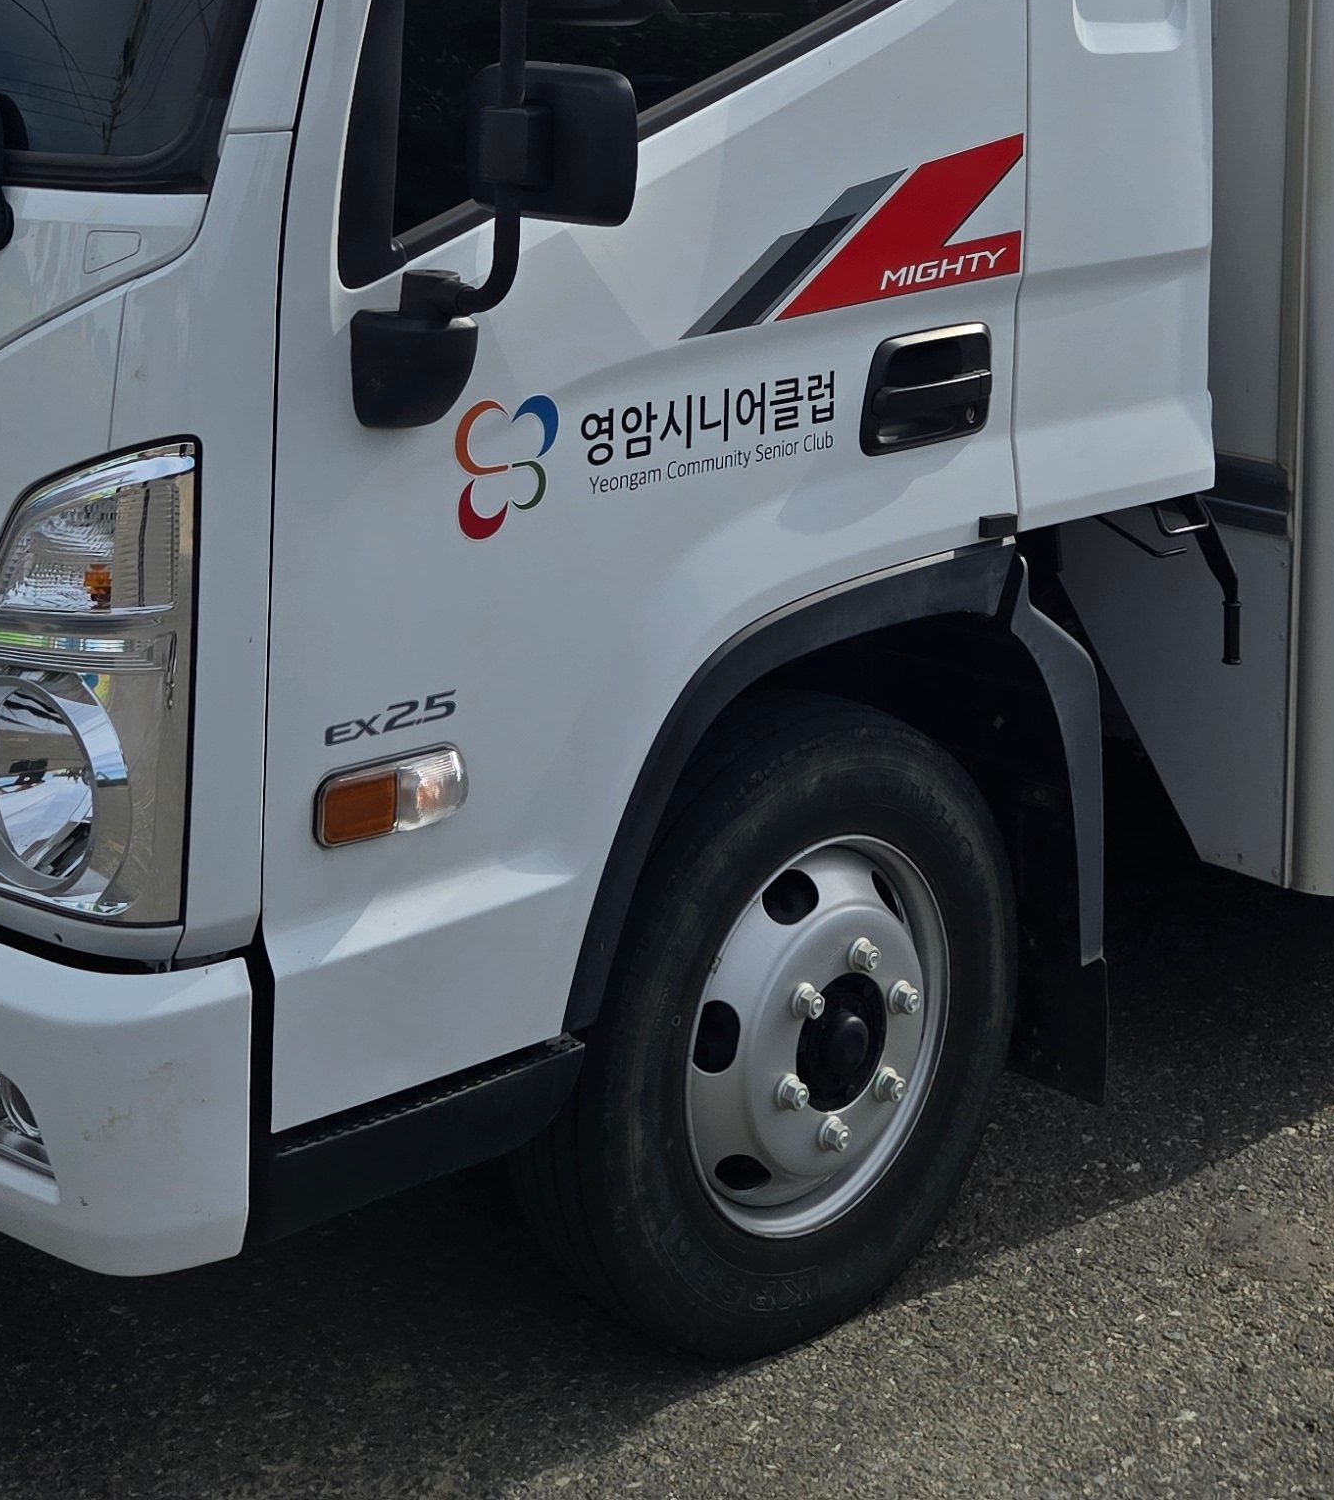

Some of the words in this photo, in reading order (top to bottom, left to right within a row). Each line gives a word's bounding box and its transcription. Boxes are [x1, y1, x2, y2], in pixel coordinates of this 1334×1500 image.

[880, 246, 1007, 292] MIGHTY
[579, 370, 837, 467] 영암시니어클럽
[589, 467, 662, 495] Yeongam
[666, 449, 751, 481] Community
[755, 438, 799, 463] Senior
[803, 431, 834, 453] Club
